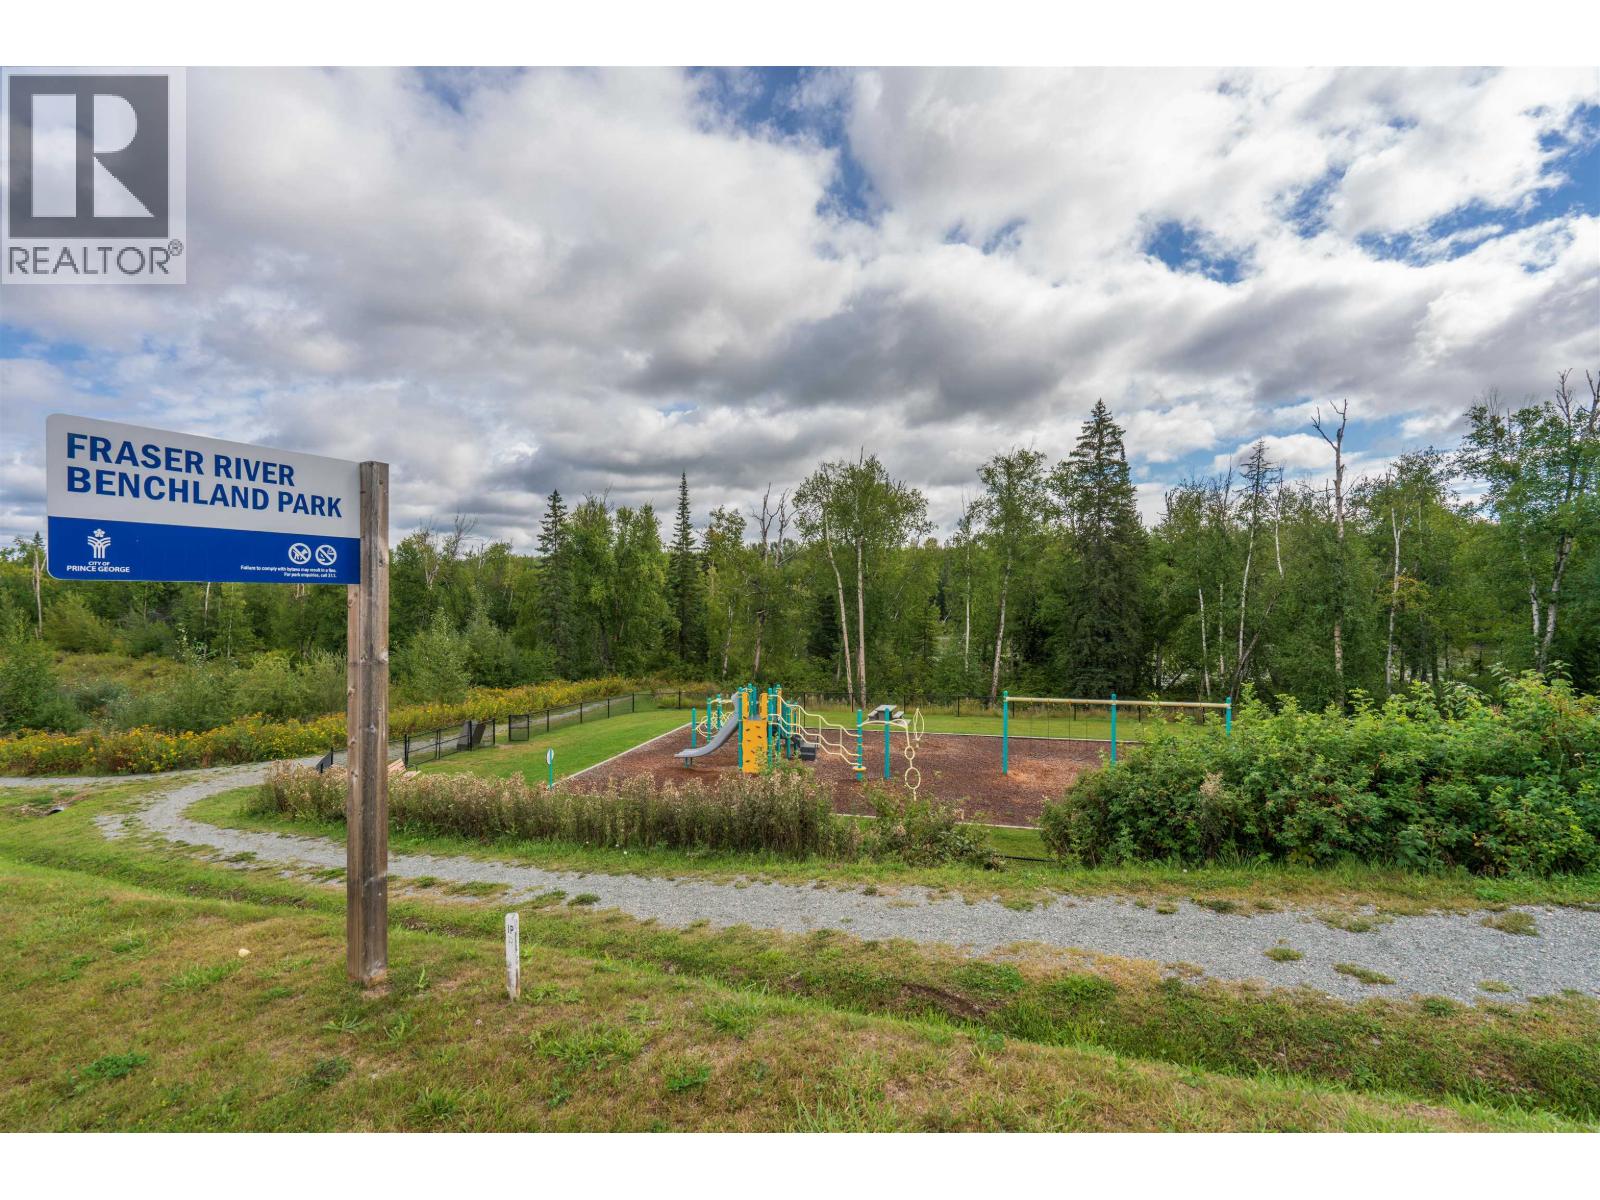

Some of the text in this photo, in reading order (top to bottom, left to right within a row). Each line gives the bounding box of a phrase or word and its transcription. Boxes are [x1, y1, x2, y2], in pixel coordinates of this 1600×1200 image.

[66, 432, 295, 487] FRASER RIVER
[66, 465, 342, 518] BENCHLAND PARK
